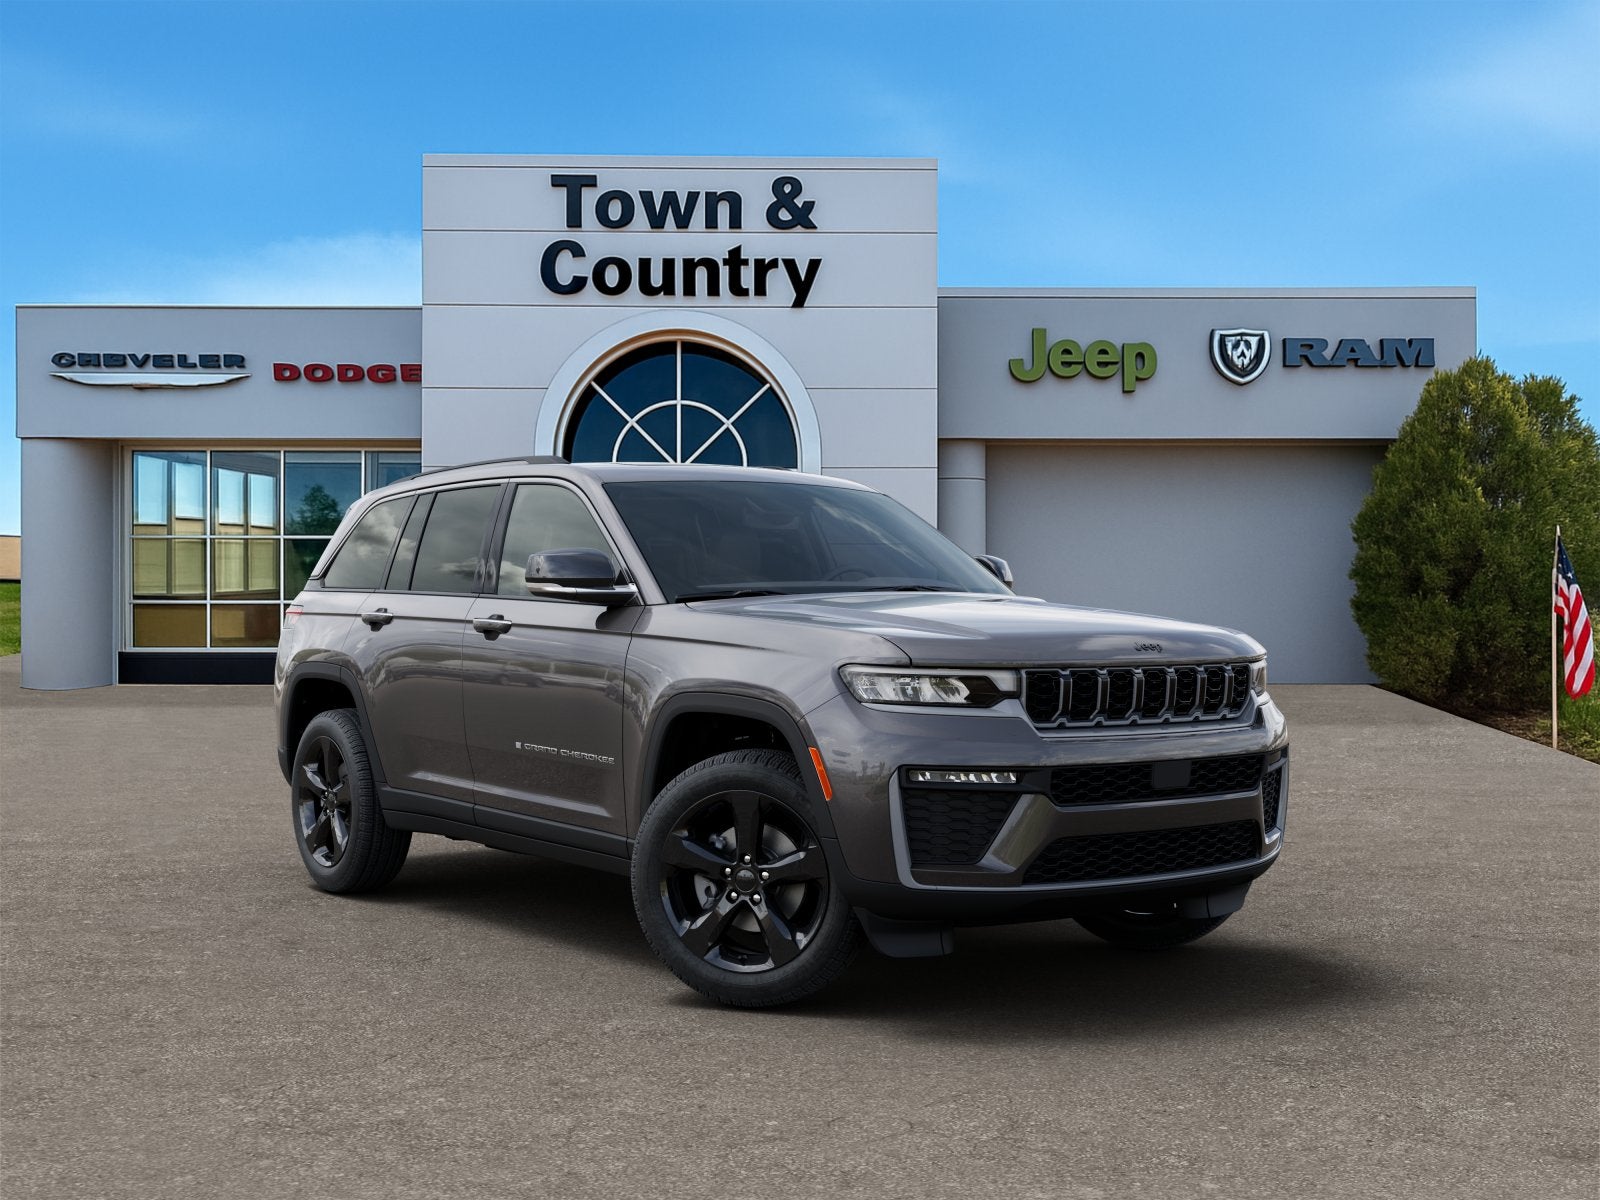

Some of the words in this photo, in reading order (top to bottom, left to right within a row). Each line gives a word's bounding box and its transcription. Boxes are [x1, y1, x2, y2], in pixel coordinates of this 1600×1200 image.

[550, 174, 743, 230] Town
[765, 176, 818, 230] &
[540, 239, 822, 308] Country
[273, 363, 421, 383] DODGE
[1009, 328, 1157, 392] Jeep
[1282, 338, 1435, 367] RAM
[1134, 641, 1162, 653] Jeep
